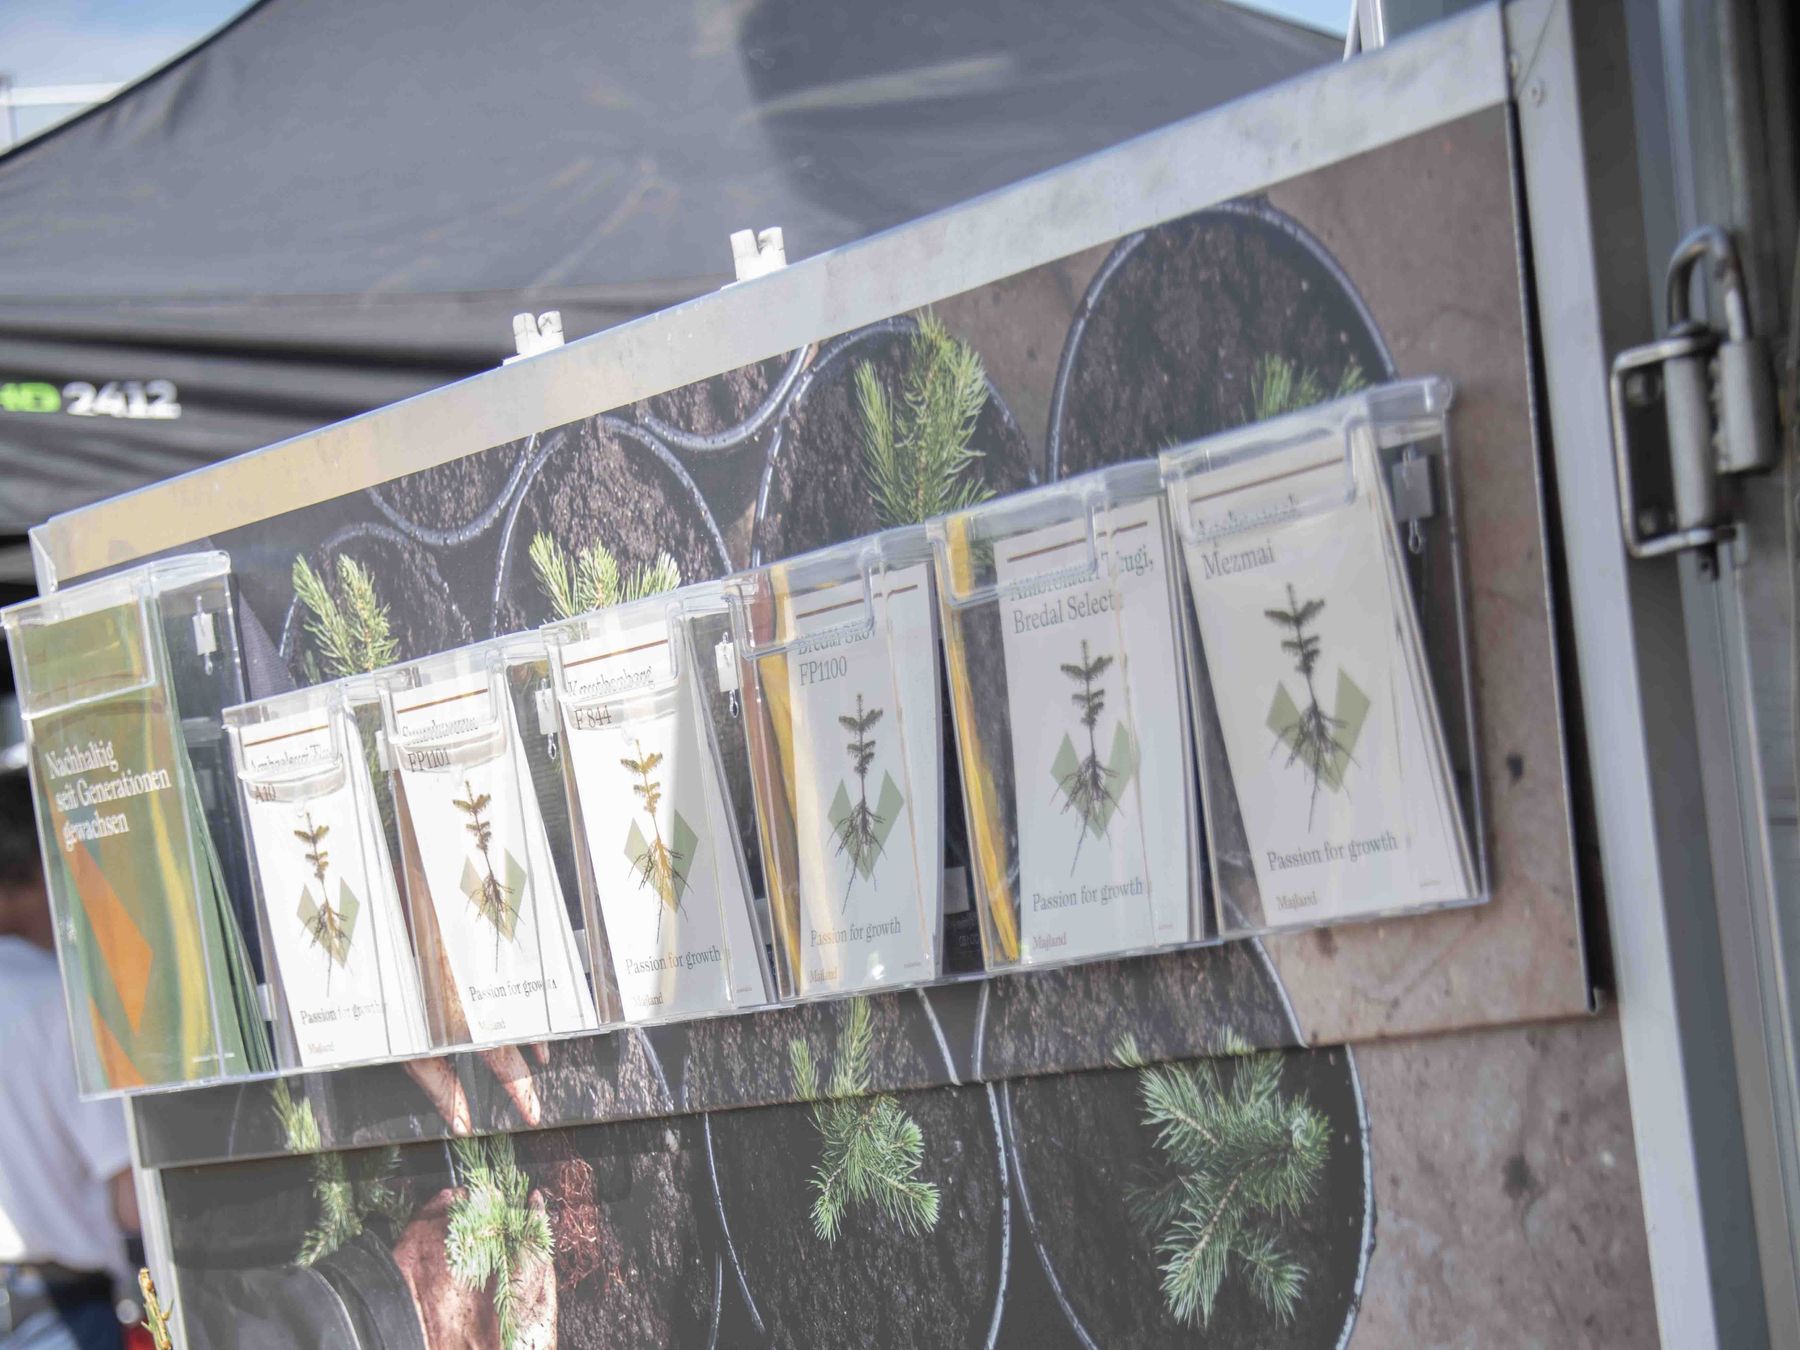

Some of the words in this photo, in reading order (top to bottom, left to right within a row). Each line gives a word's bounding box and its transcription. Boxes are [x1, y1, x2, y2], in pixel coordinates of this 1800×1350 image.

[62, 380, 182, 420] 2412
[1201, 538, 1276, 580] Mezmai
[1013, 600, 1065, 634] Bredal
[1068, 590, 1117, 621] Select
[799, 656, 847, 686] FP1100
[586, 704, 612, 728] 844
[44, 740, 119, 779] Nachhaltig
[407, 747, 451, 773] FP1101
[55, 783, 79, 812] seit
[76, 768, 172, 807] Generationen
[62, 810, 130, 852] gewachsen
[1266, 848, 1322, 872] Passion
[1323, 841, 1345, 862] for
[1348, 831, 1398, 862] growth
[1032, 890, 1077, 912] Passion
[1080, 885, 1098, 904] for
[1100, 876, 1143, 905] growth
[810, 928, 848, 947] Passion
[849, 922, 864, 941] for
[865, 916, 902, 943] growth
[625, 956, 667, 975] Passion
[668, 952, 683, 969] for
[685, 945, 722, 970] growth
[300, 1008, 337, 1025] Passion
